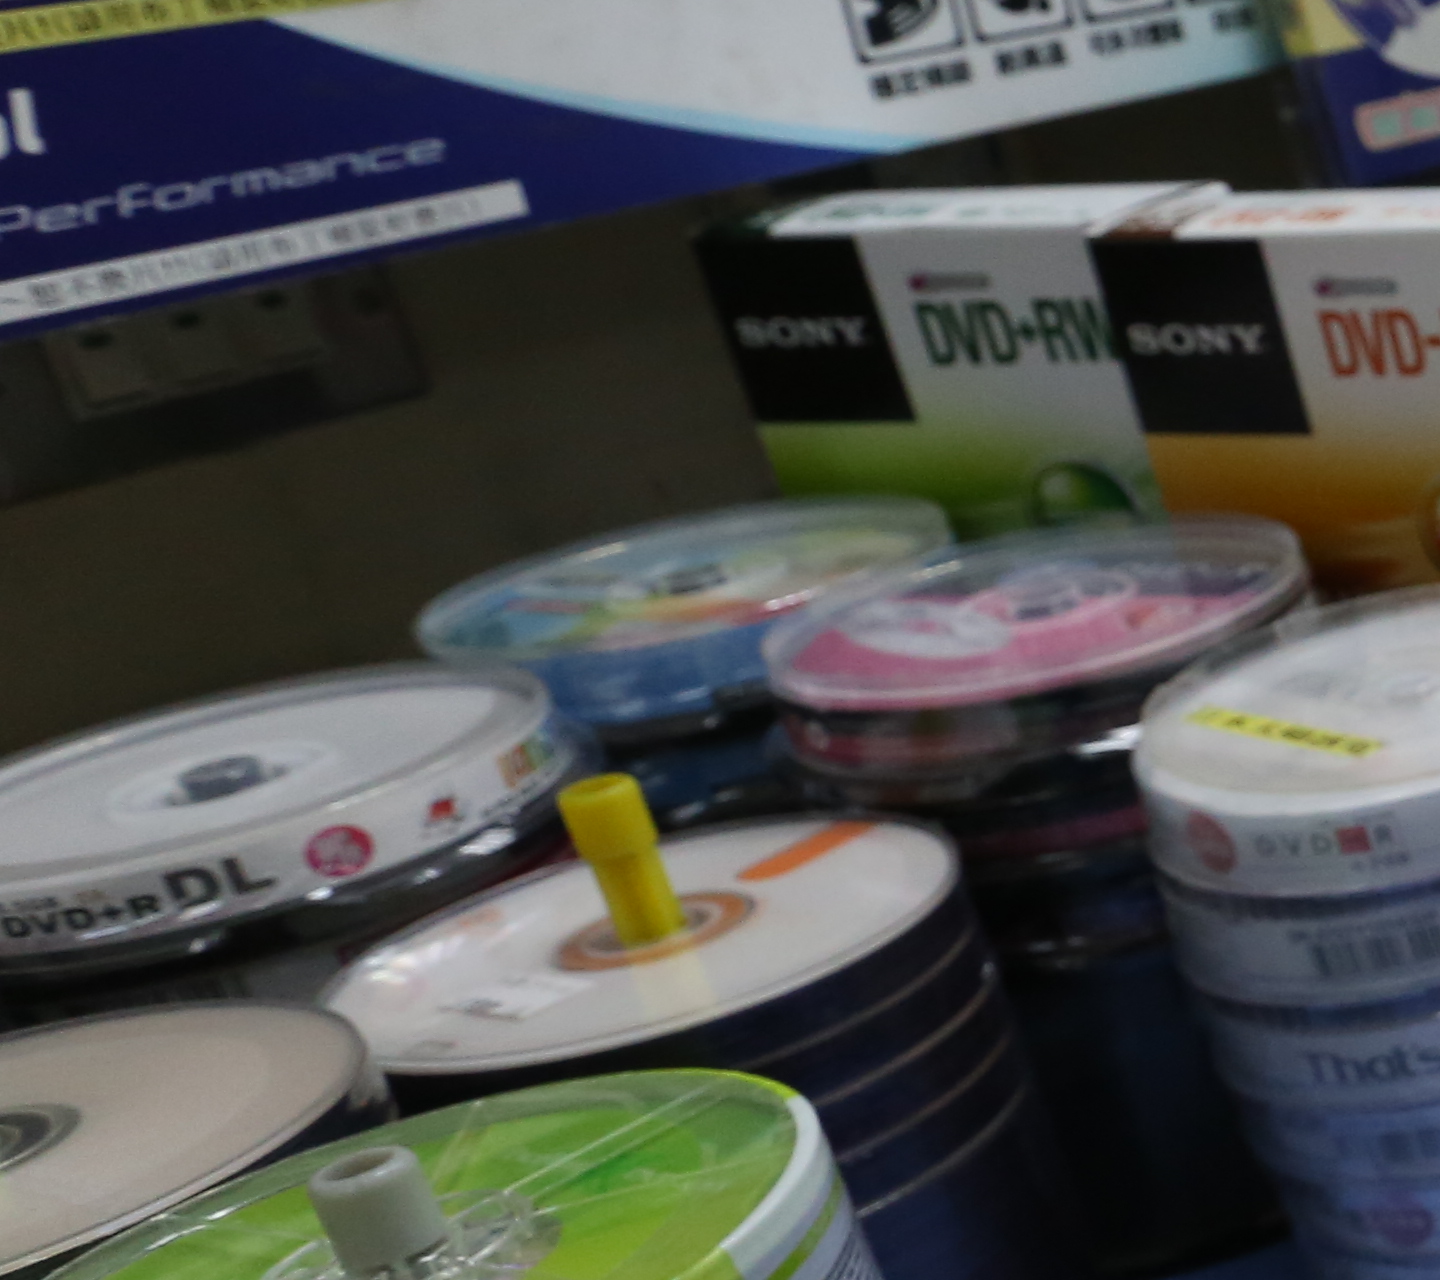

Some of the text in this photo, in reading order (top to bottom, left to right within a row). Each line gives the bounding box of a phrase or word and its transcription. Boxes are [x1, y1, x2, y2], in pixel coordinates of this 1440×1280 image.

[736, 317, 867, 349] SONY
[1126, 323, 1265, 358] SONY
[162, 856, 276, 910] DL
